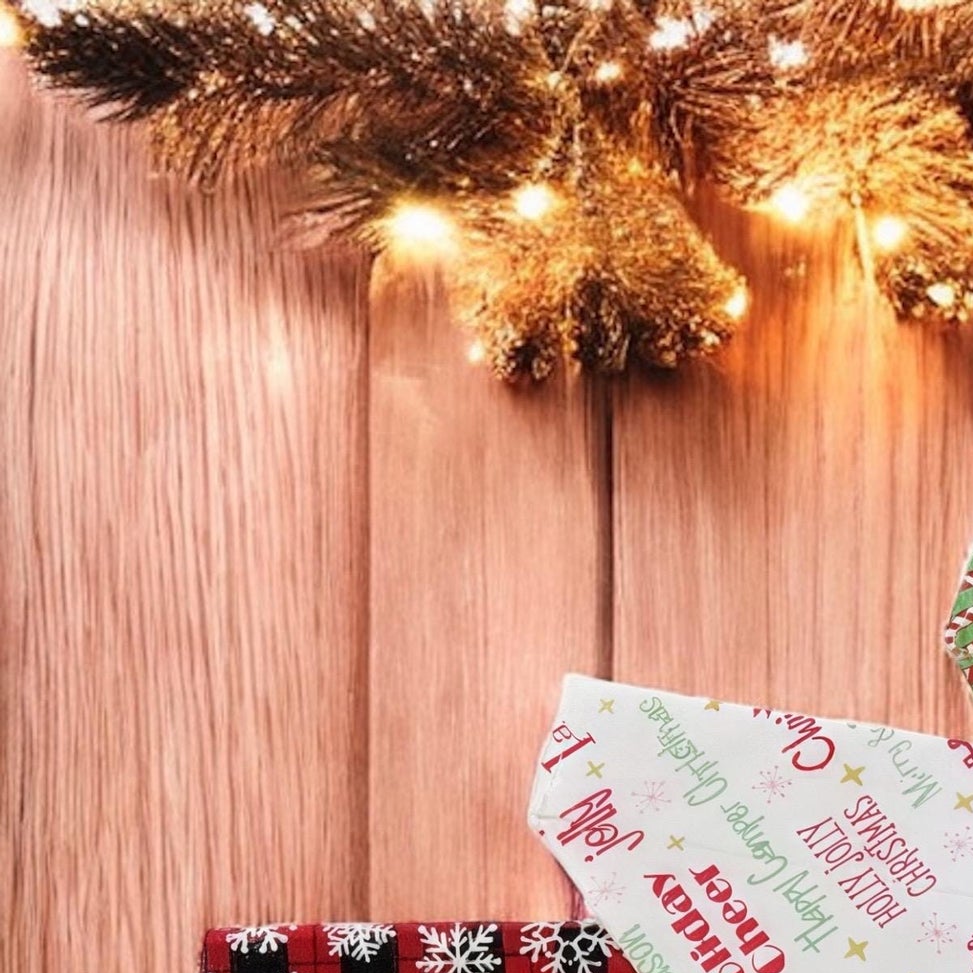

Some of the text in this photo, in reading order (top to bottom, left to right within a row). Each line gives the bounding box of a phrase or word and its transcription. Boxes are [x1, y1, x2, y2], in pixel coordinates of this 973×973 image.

[752, 706, 835, 771] Chri
[843, 794, 936, 897] CHRISTMAS
[771, 869, 839, 953] Happy
[837, 866, 907, 928] HOLLY
